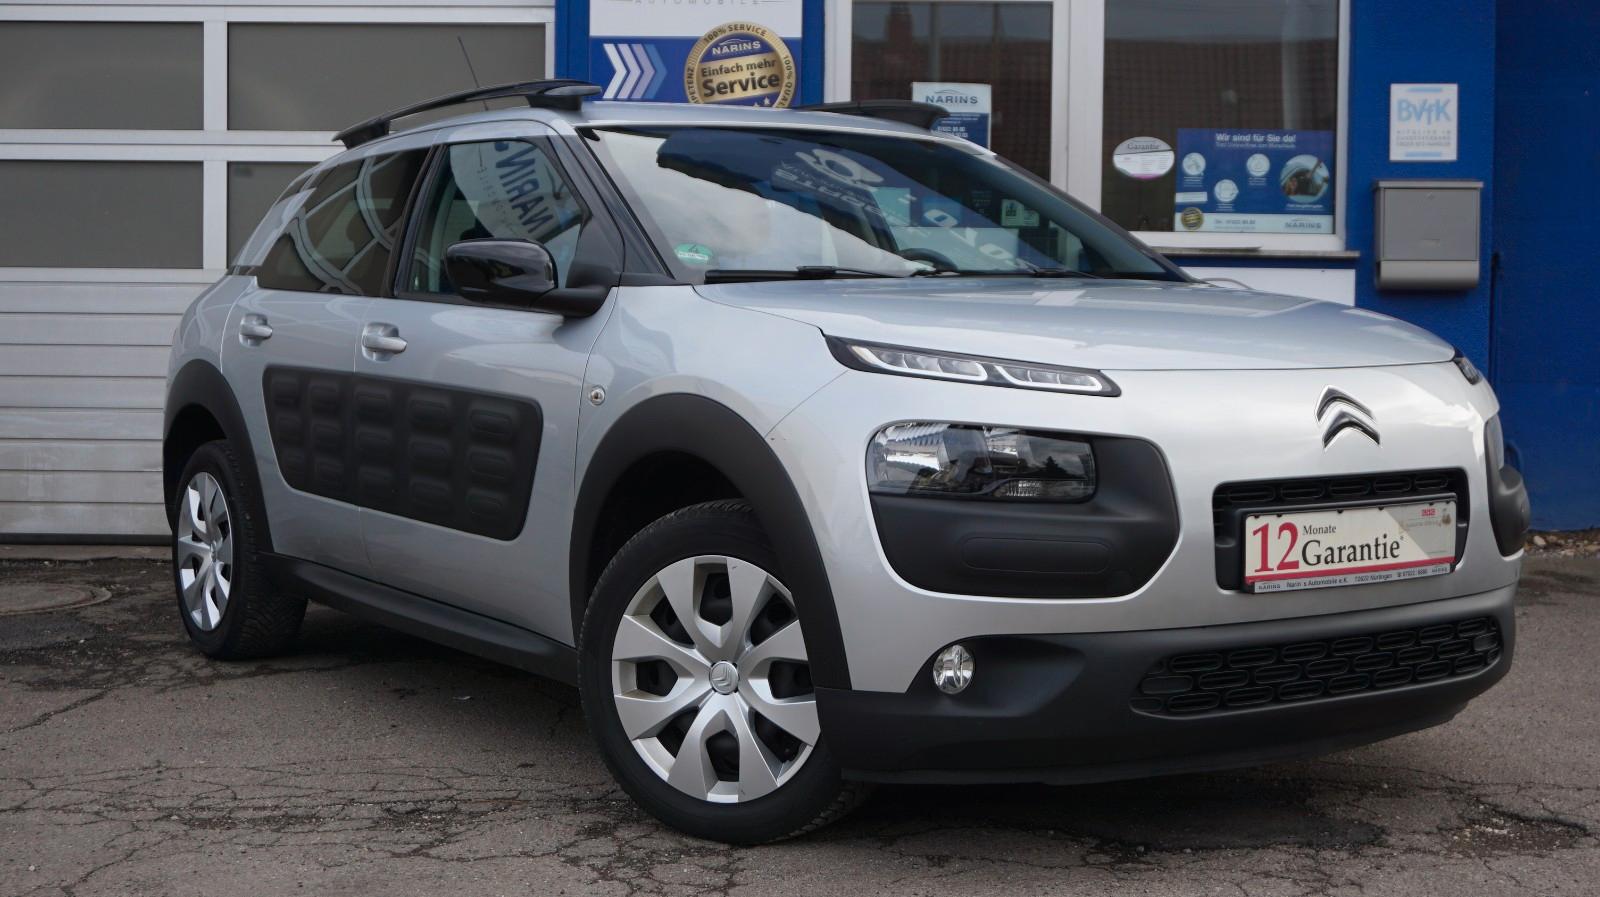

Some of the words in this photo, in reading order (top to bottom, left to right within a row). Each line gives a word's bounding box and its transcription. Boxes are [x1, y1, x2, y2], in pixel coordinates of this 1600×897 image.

[728, 23, 768, 37] SERVICE
[712, 41, 761, 55] NARINS
[701, 64, 744, 78] Einfach
[746, 58, 777, 70] mehr
[702, 72, 780, 98] Service
[925, 95, 979, 105] NARINS
[1215, 132, 1230, 142] Wir
[1232, 133, 1251, 142] sind
[1253, 133, 1265, 142] für
[1267, 133, 1281, 142] Sie
[1283, 133, 1297, 143] da!
[1252, 521, 1299, 573] 12
[1302, 525, 1337, 536] Monate
[1302, 533, 1401, 566] Garantie
